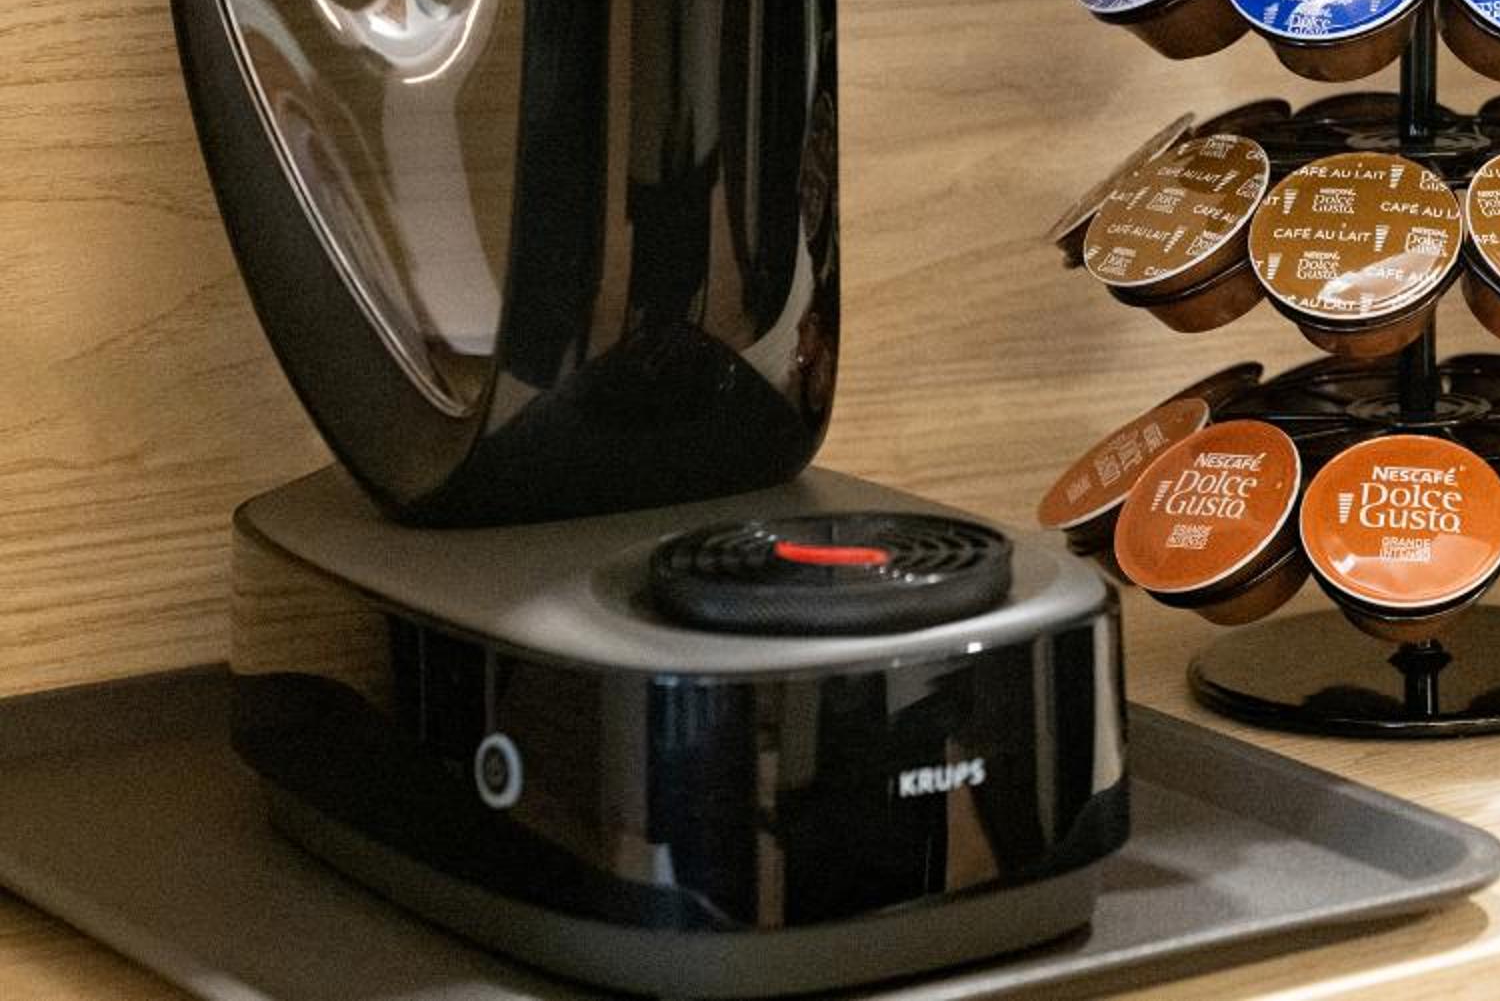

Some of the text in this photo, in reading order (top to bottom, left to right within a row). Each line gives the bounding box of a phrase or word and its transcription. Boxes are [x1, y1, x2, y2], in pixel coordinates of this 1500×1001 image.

[1329, 168, 1351, 179] AU
[1354, 168, 1386, 180] LAIT
[1422, 207, 1443, 219] AU
[1314, 229, 1336, 240] AU
[1338, 229, 1373, 242] LAIT
[1194, 451, 1267, 471] NESCAFÉ
[1173, 469, 1258, 498] Dolce
[1371, 465, 1458, 486] NESCAFÉ
[1165, 490, 1246, 519] Gusto
[1360, 483, 1463, 511] Dolce
[1359, 505, 1461, 533] Gusto
[899, 757, 986, 797] KRUPS
